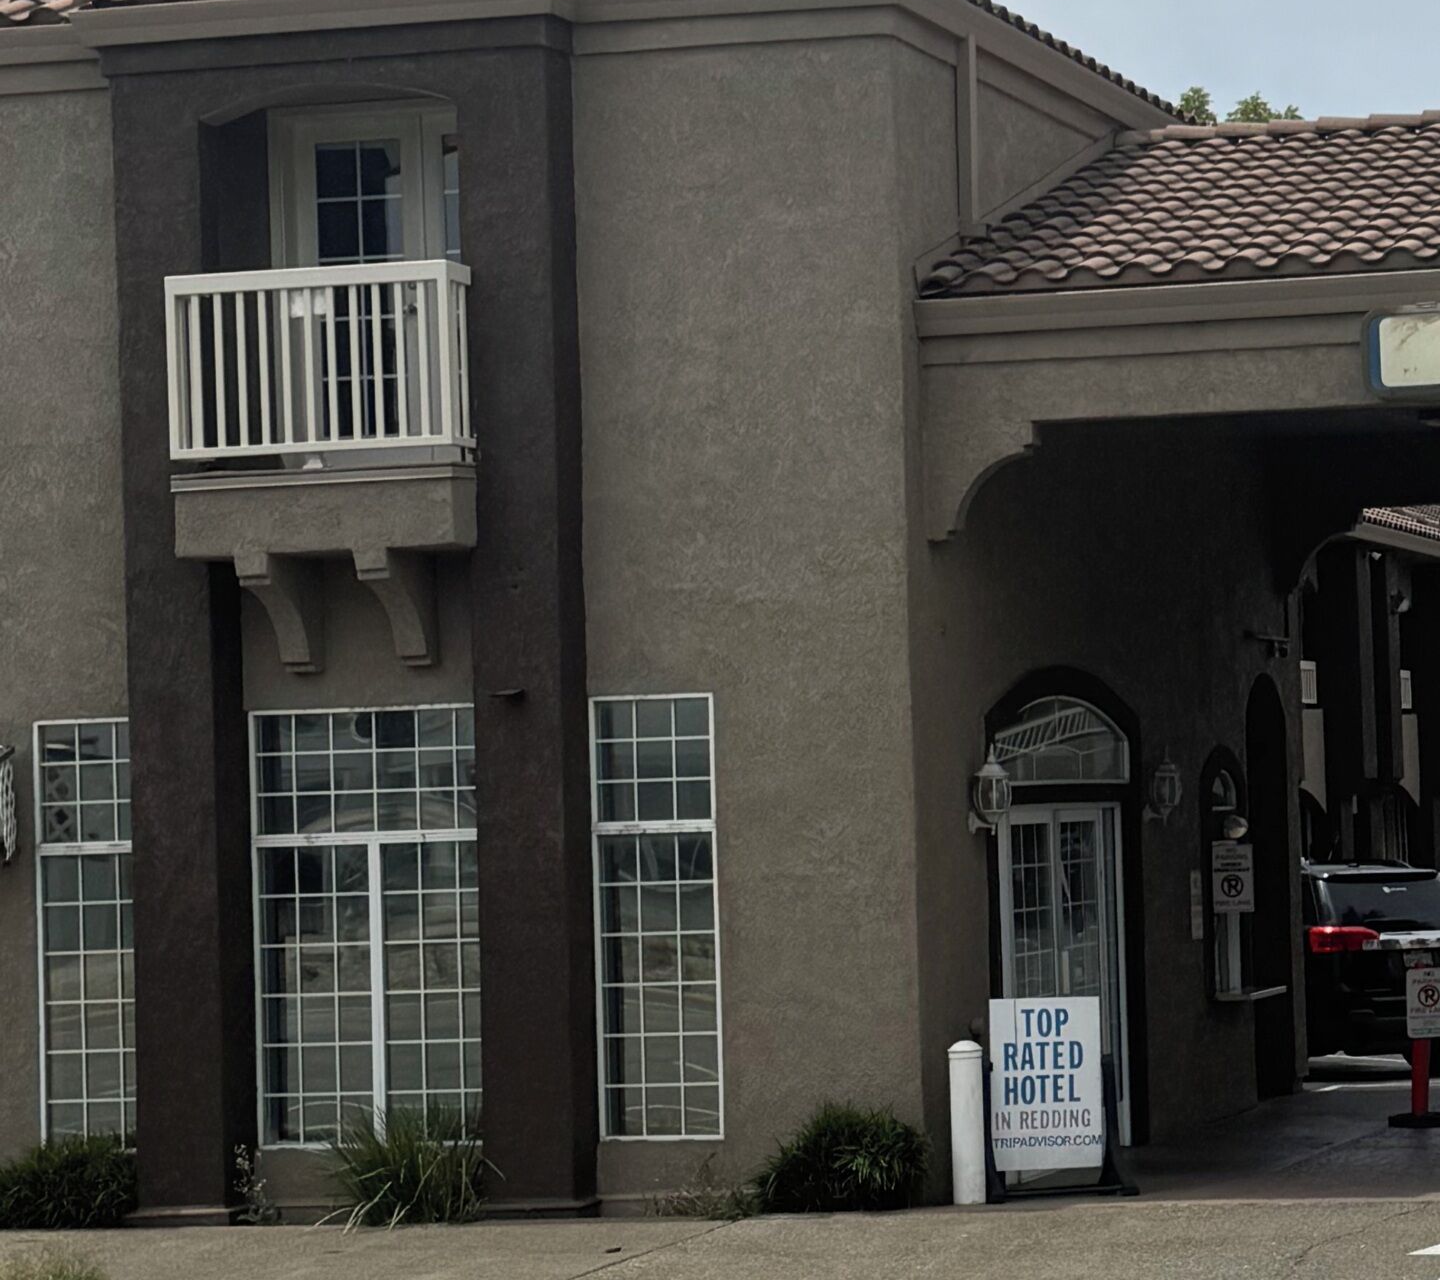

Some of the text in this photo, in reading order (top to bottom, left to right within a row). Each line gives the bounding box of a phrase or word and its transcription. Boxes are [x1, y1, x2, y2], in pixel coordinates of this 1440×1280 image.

[1020, 1008, 1069, 1037] TOP
[1003, 1041, 1083, 1071] RATED
[1004, 1074, 1081, 1106] HOTEL
[995, 1108, 1091, 1131] IN REDDING
[993, 1134, 1102, 1149] TRIPADVISOR.COM
